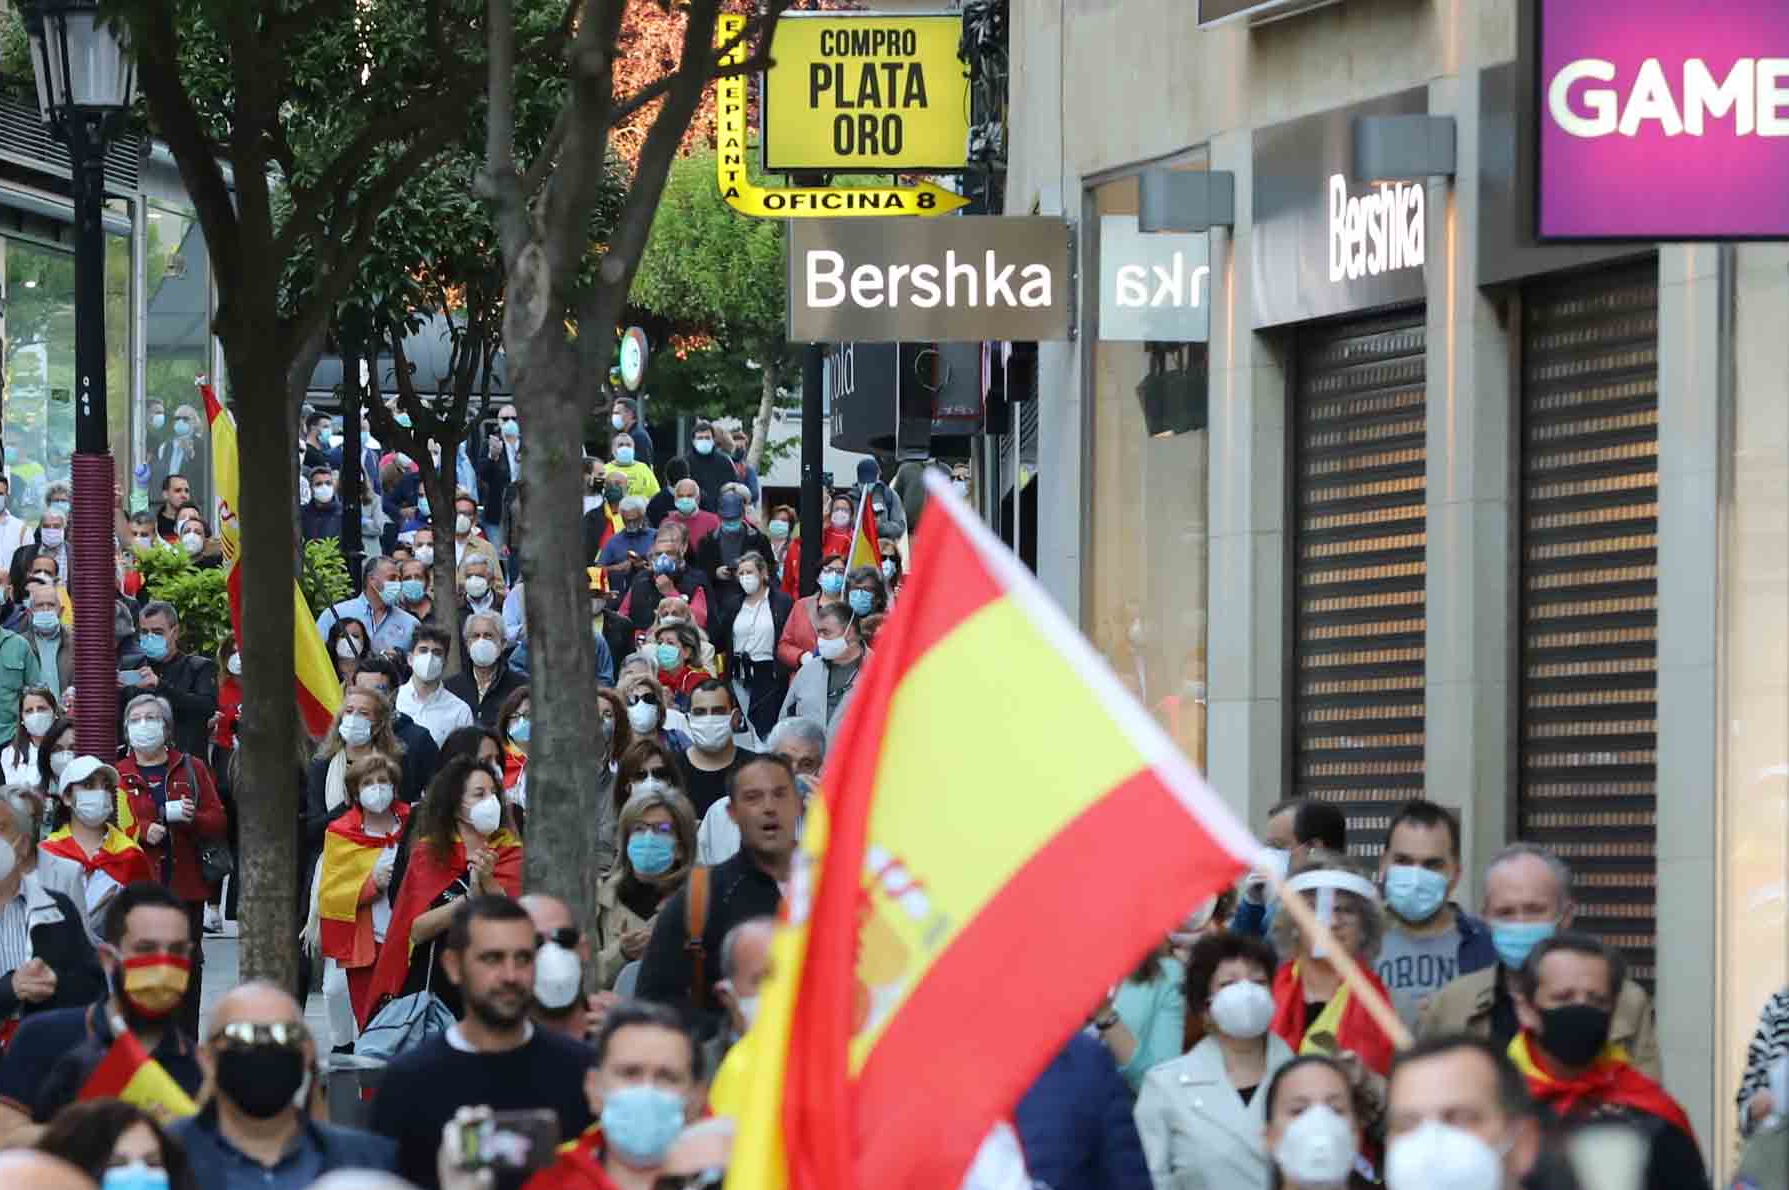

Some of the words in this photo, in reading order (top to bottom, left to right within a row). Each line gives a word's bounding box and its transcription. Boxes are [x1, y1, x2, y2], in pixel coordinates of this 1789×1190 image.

[820, 29, 916, 57] COMPRO
[724, 20, 740, 199] ETEPLANTA
[809, 63, 929, 109] PLATA
[1548, 57, 1789, 138] GAME
[833, 114, 903, 156] ORO
[762, 193, 905, 210] OFICINA
[916, 192, 936, 210] 8
[1329, 173, 1425, 282] Bershka
[805, 249, 1053, 309] Bershka
